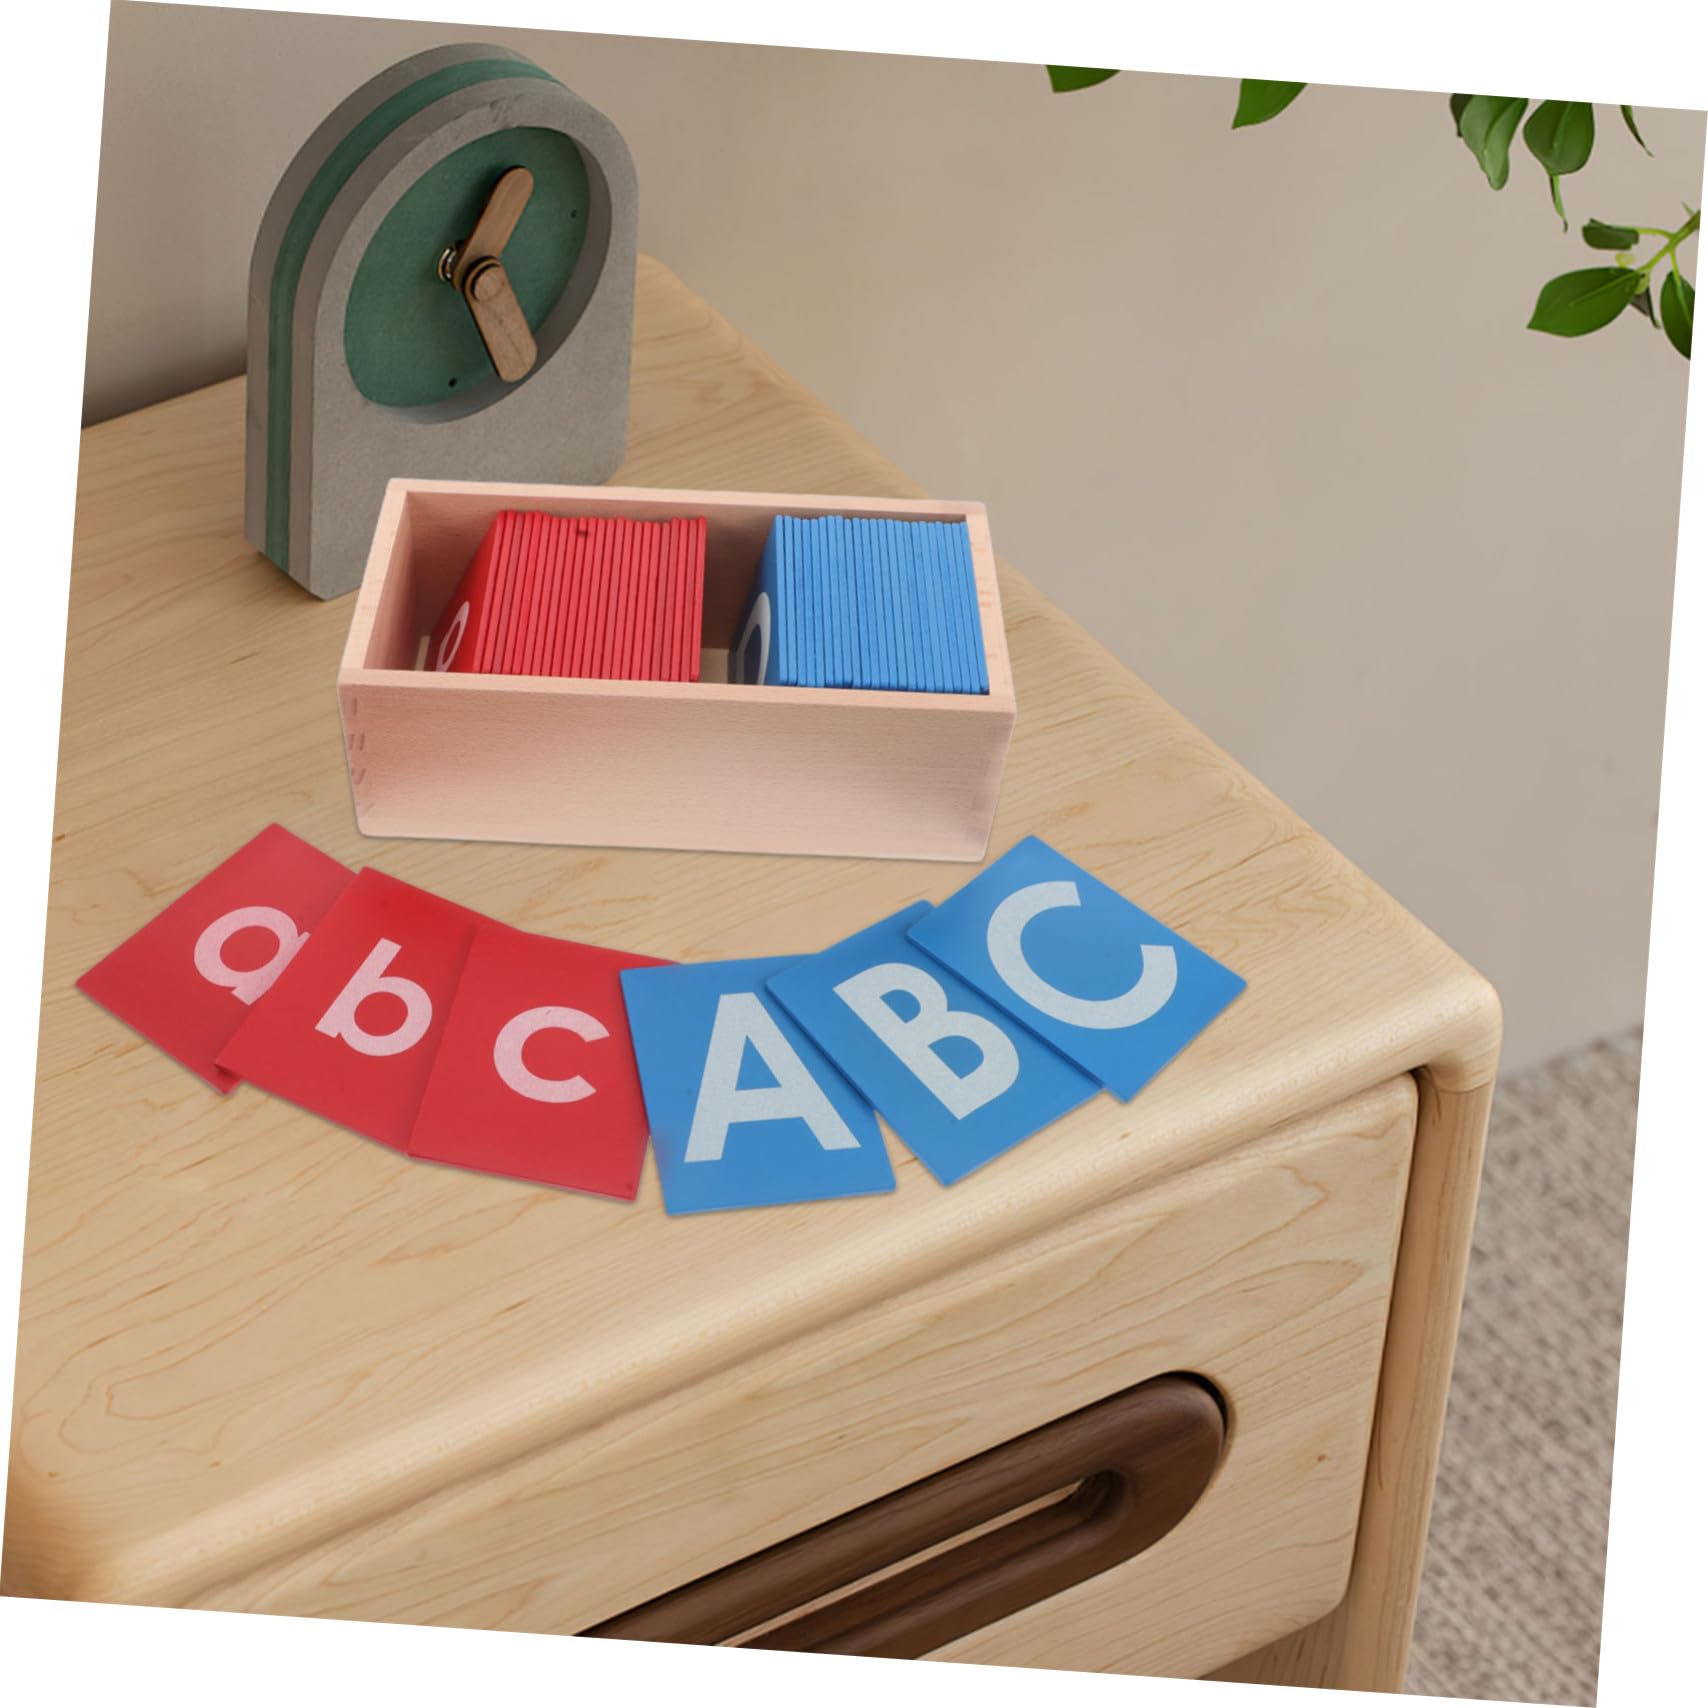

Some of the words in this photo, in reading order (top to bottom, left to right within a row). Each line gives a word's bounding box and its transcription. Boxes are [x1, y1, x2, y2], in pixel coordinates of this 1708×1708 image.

[194, 905, 310, 1006] a
[315, 937, 432, 1057] b
[986, 880, 1178, 1030] C
[493, 1005, 610, 1104] c
[684, 992, 861, 1163] A
[832, 962, 1020, 1120] B
